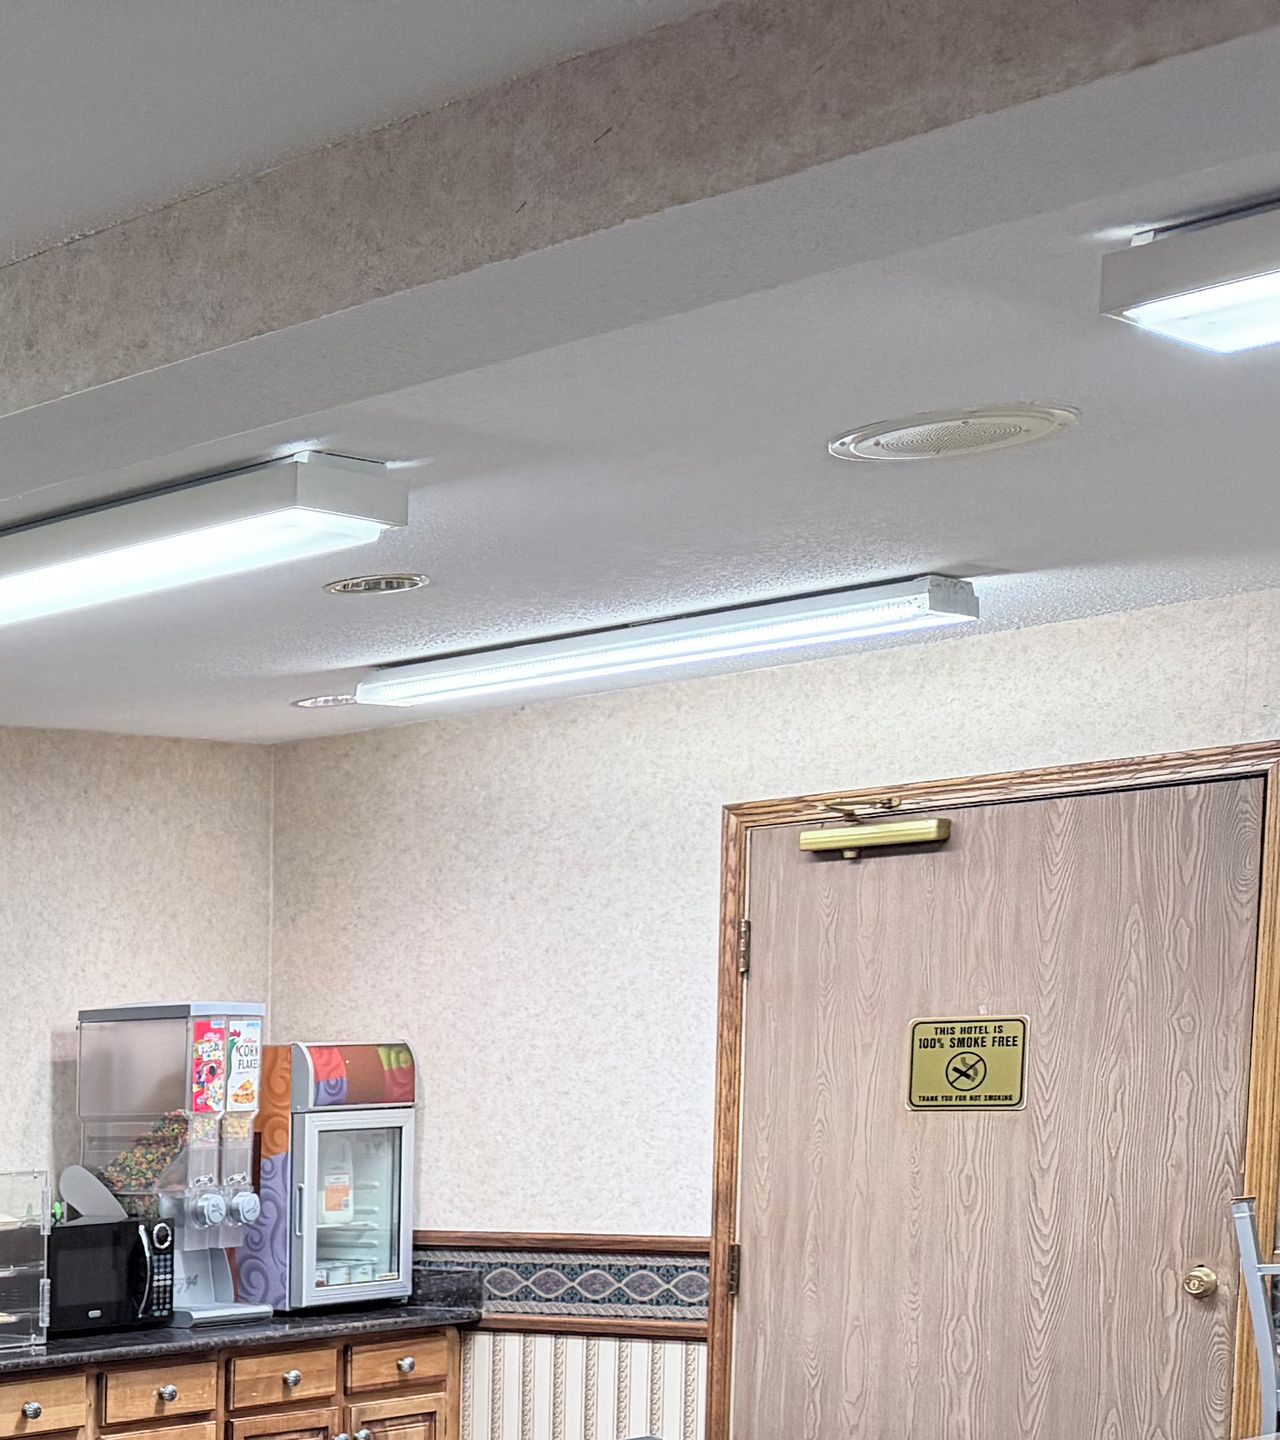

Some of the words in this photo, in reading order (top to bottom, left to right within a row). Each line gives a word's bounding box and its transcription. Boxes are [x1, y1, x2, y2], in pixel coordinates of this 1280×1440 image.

[934, 1026, 956, 1036] THIS
[960, 1025, 989, 1035] HOTEL
[993, 1025, 1004, 1034] IS
[918, 1037, 945, 1049] 100%
[949, 1036, 987, 1048] SMOKE
[992, 1035, 1019, 1047] FREE
[955, 1094, 967, 1102] FOR
